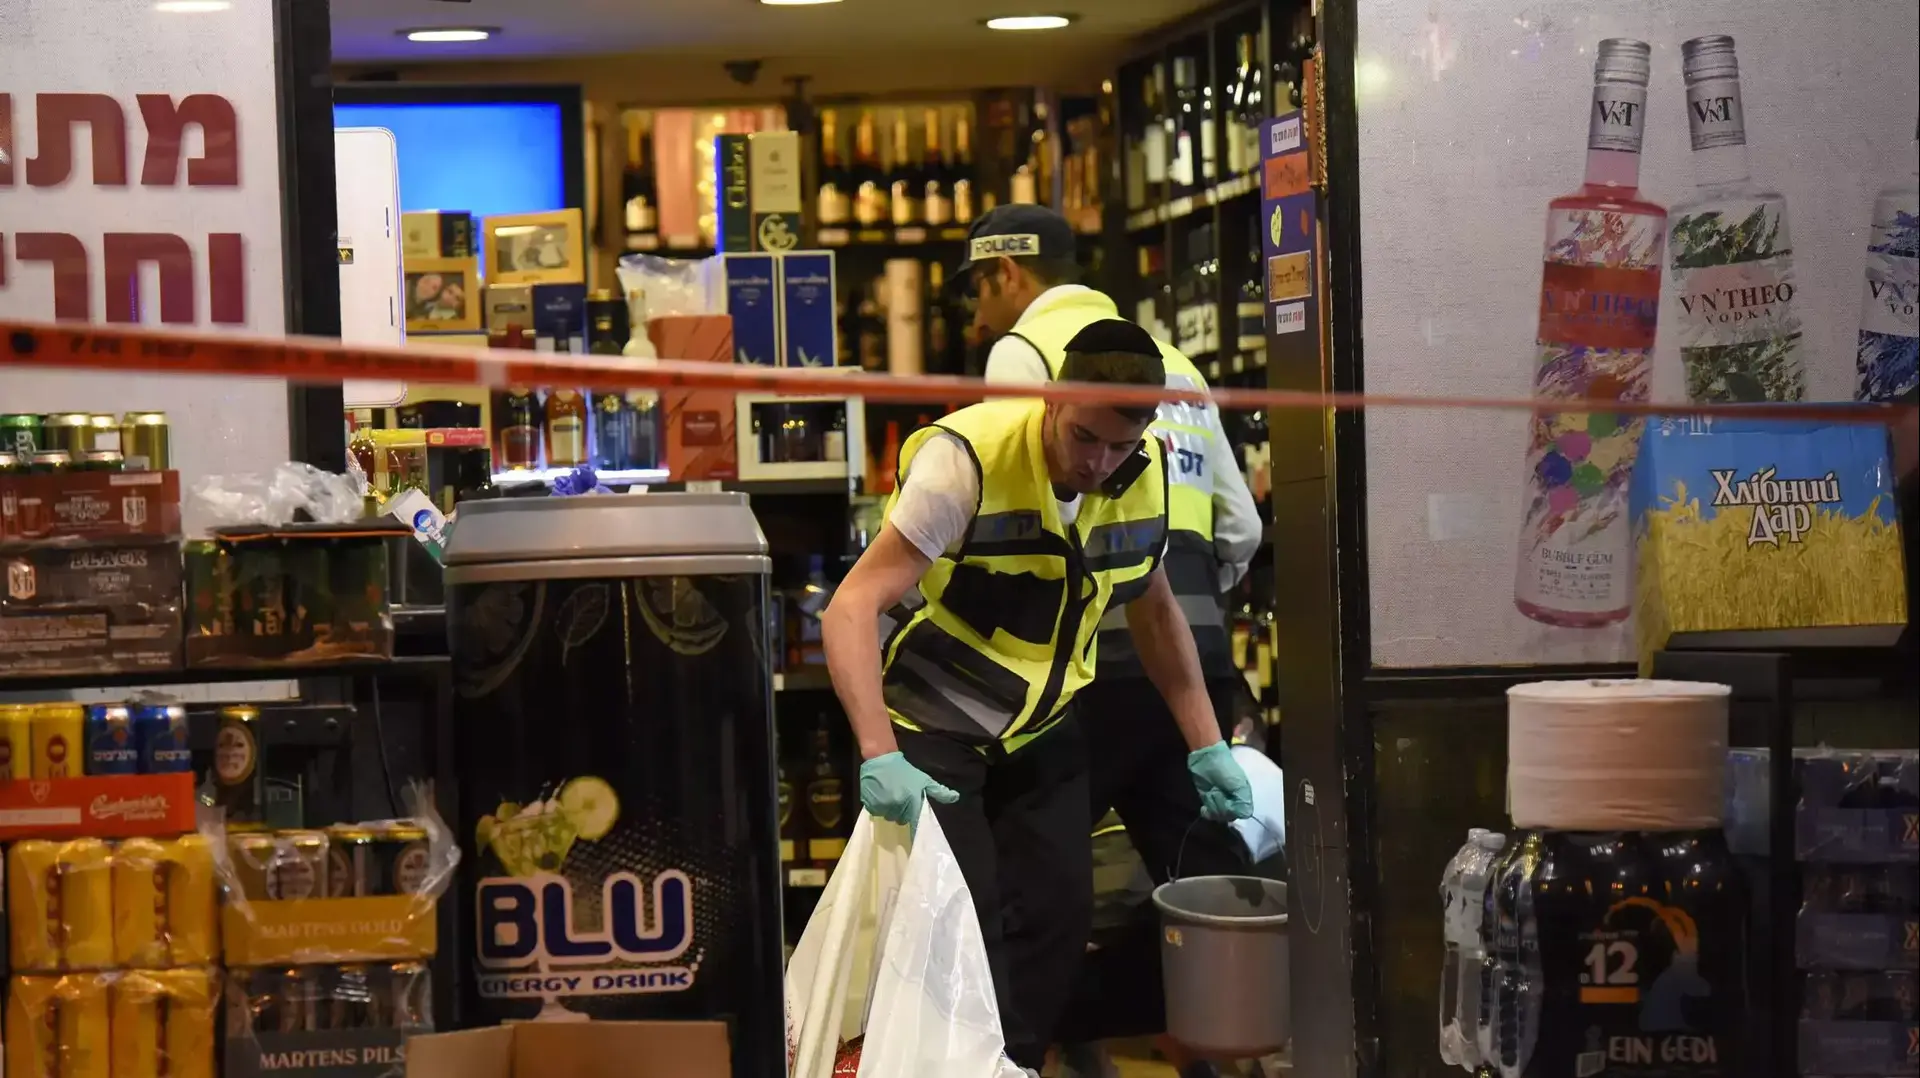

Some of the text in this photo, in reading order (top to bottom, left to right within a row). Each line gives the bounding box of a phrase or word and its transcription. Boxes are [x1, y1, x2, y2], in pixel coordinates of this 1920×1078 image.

[0, 92, 238, 187] מת
[975, 236, 1032, 253] POLICE
[0, 232, 245, 324] וחר
[1706, 308, 1772, 325] VODKA
[1708, 464, 1843, 506] Хлібний
[1746, 501, 1812, 551] Дар
[70, 552, 148, 569] BLACK
[261, 919, 403, 939] MARTENS GOLD
[480, 873, 691, 962] BLU
[481, 971, 689, 993] ENERGY DRINK
[260, 1046, 406, 1069] MARTENS PILS
[1609, 1035, 1717, 1064] EIN GEDI
